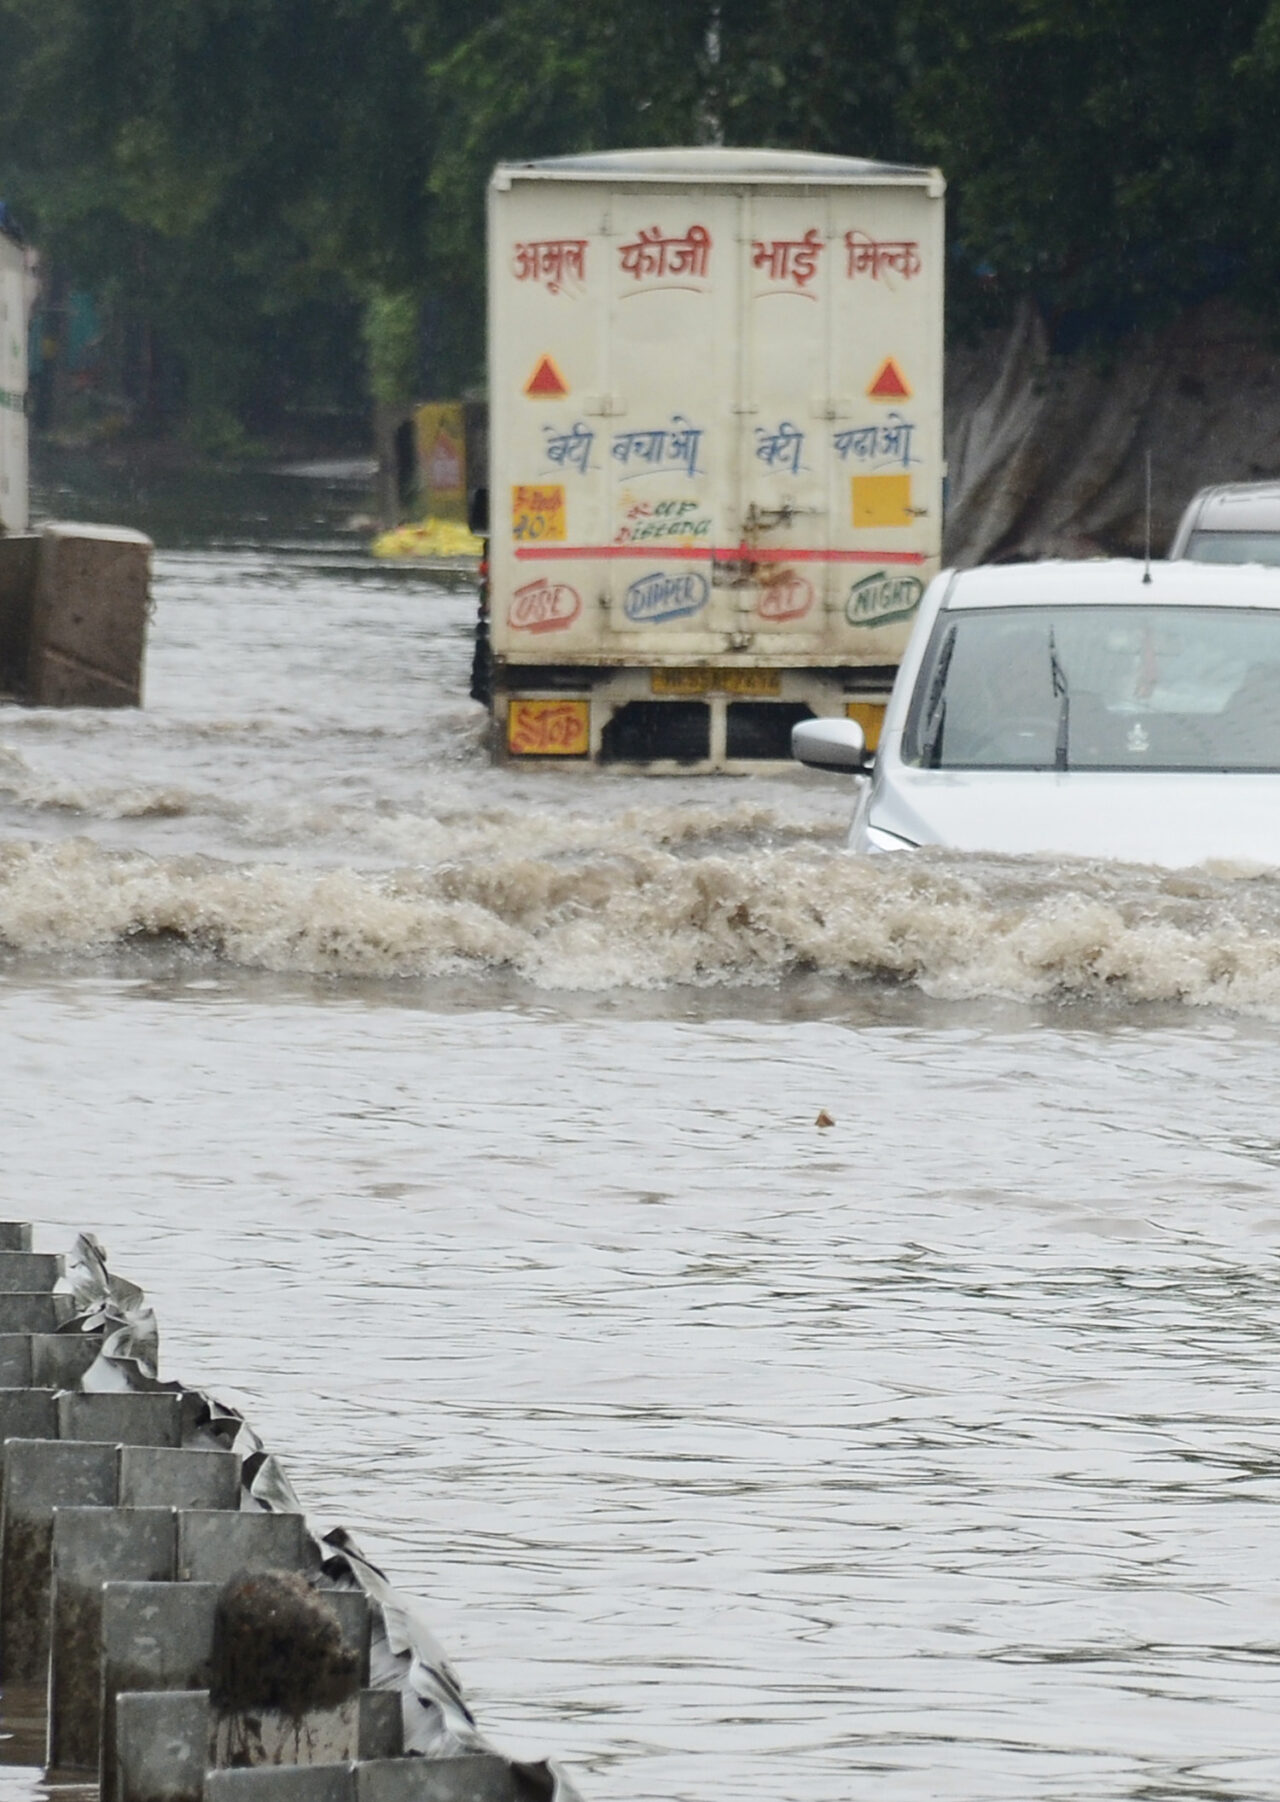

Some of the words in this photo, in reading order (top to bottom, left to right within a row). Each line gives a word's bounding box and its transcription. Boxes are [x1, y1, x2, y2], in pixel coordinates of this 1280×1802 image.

[513, 239, 588, 294] अमूल
[751, 228, 825, 287] भाई
[844, 230, 921, 280] मिल्क
[543, 422, 594, 474] बेटी
[612, 415, 704, 477] बचाओ
[754, 422, 803, 474] बेटी
[853, 580, 915, 615] NIGHT
